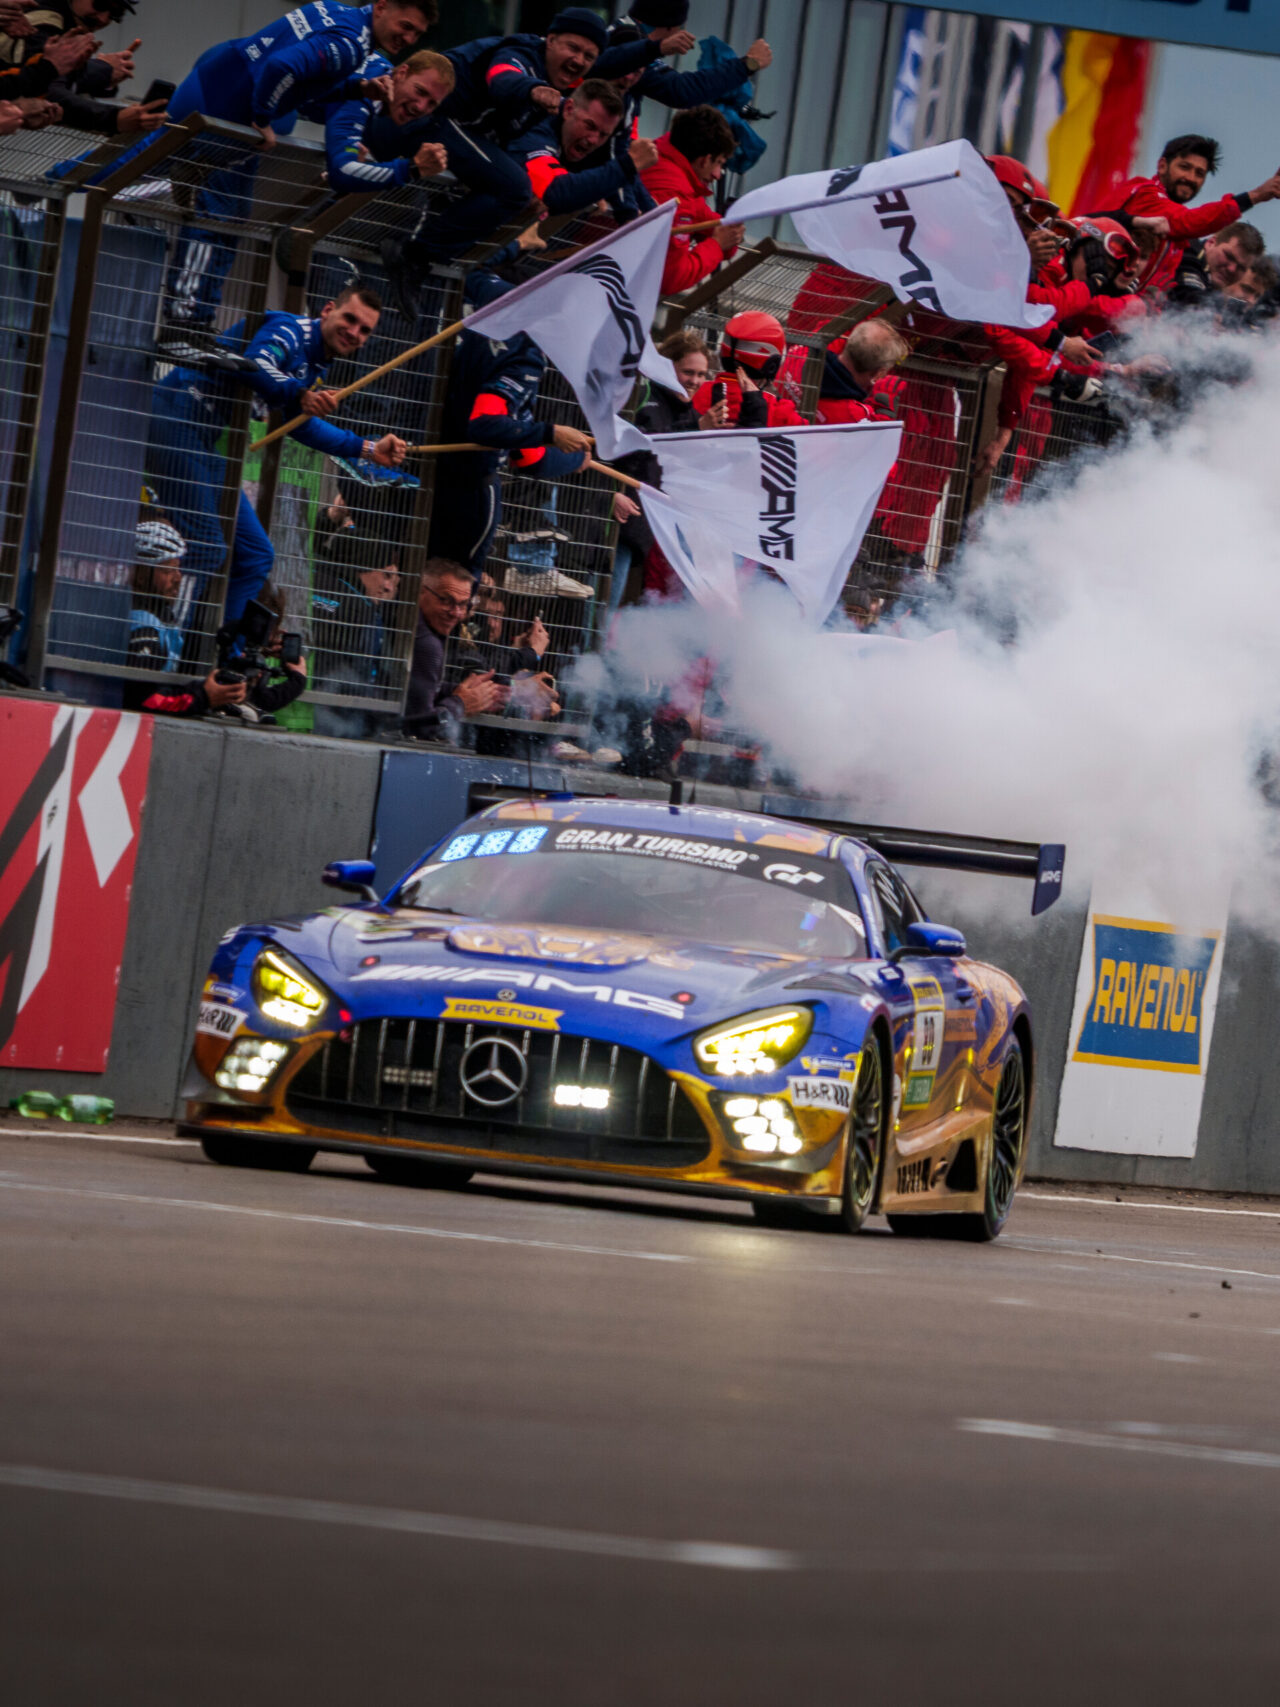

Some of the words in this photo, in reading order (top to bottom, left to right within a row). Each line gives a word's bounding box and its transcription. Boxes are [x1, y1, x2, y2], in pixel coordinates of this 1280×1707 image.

[758, 475, 796, 561] AMG
[555, 828, 632, 847] GRAN
[555, 843, 578, 851] THE
[581, 844, 612, 852] REAL
[666, 852, 738, 871] SIMULATOR
[451, 967, 686, 1020] AMG
[454, 1002, 549, 1024] RAVENOL
[1092, 957, 1199, 1034] RAVENOL
